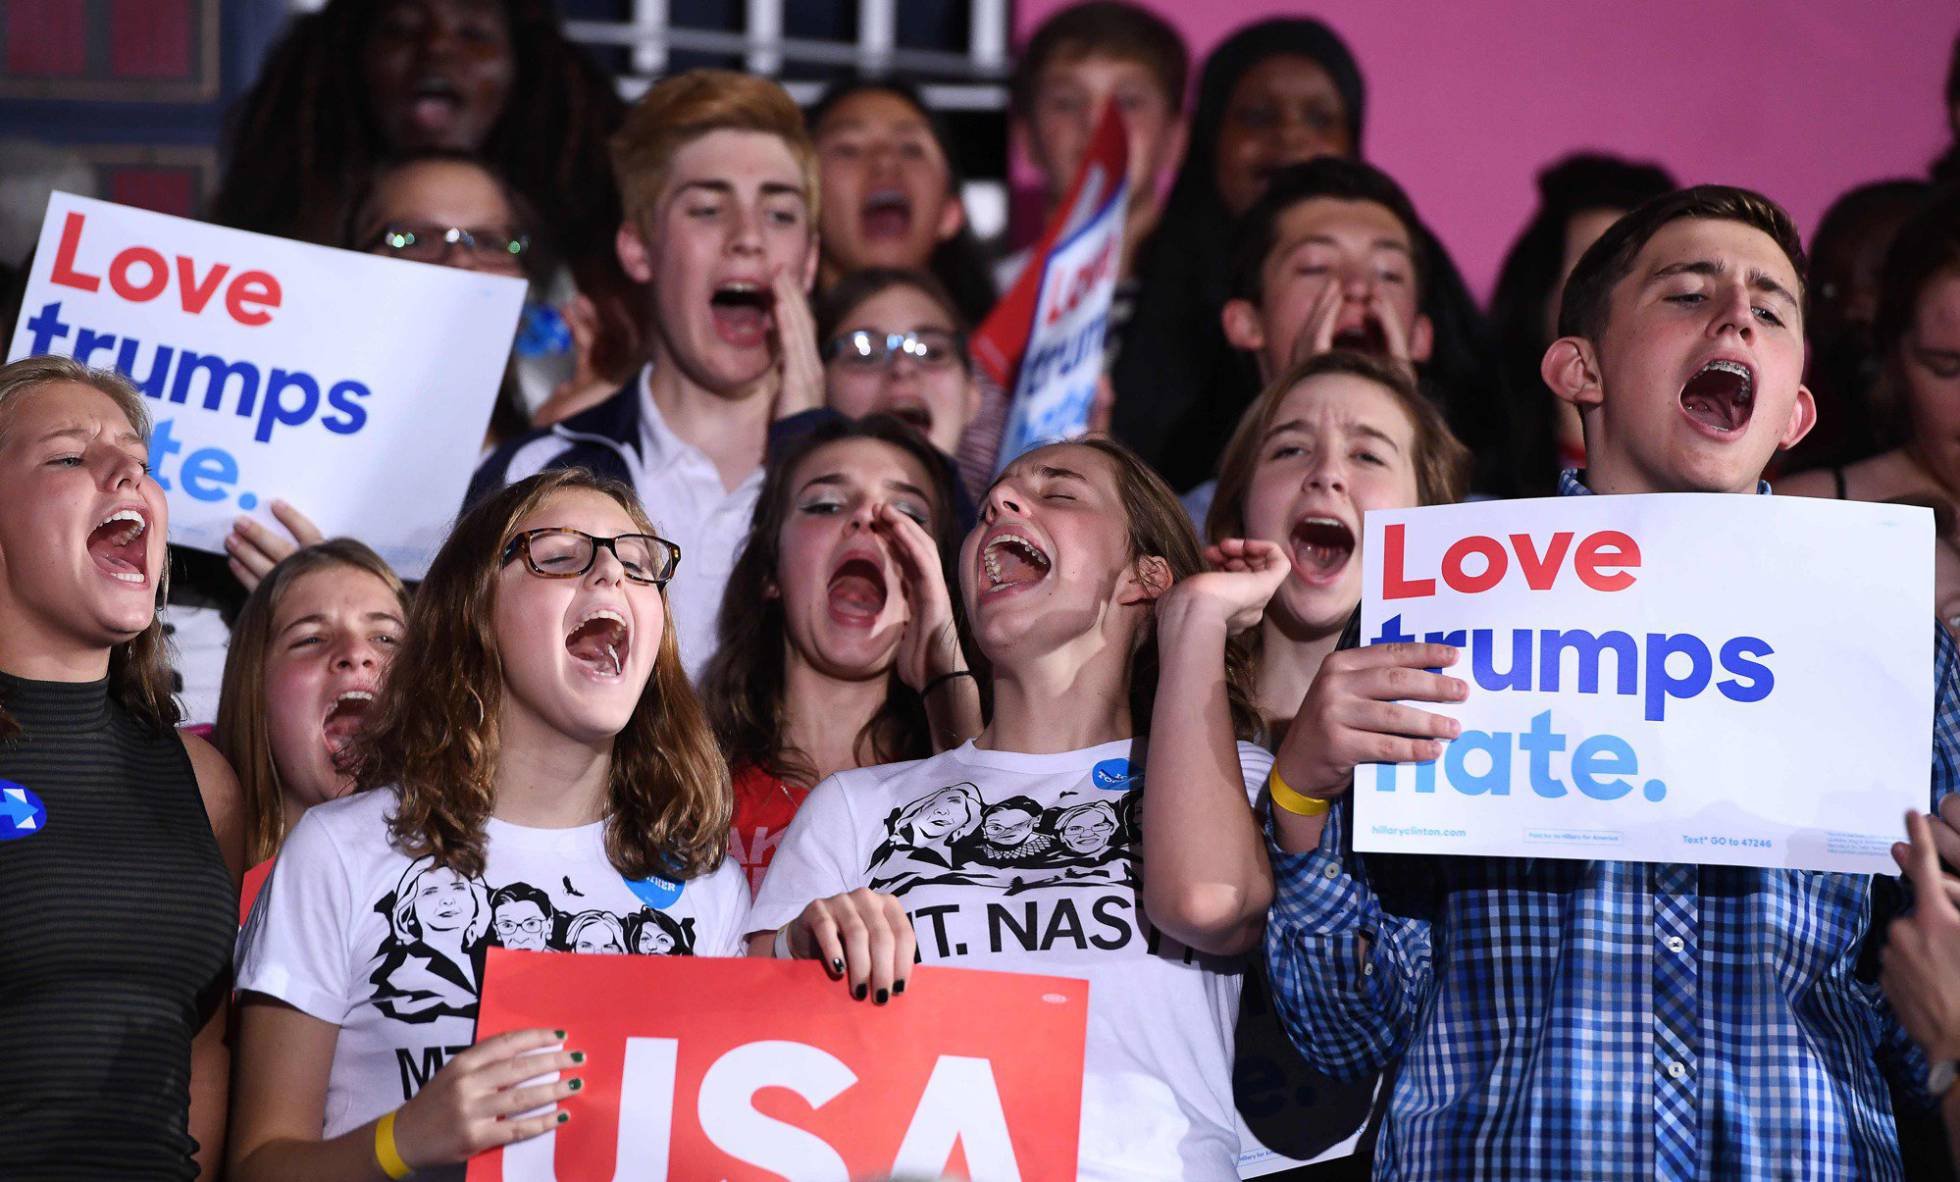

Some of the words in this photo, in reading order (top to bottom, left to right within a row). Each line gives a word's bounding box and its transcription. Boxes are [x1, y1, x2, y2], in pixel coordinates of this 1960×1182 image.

[51, 212, 282, 326] Love
[151, 416, 258, 511] te.
[1383, 523, 1641, 600] Love
[1372, 826, 1466, 838] hillaryclinton.com
[1711, 836, 1727, 845] GO
[1729, 838, 1739, 846] to
[1741, 838, 1772, 848] 47246
[907, 903, 968, 964] T.
[501, 1037, 1024, 1182] USA
